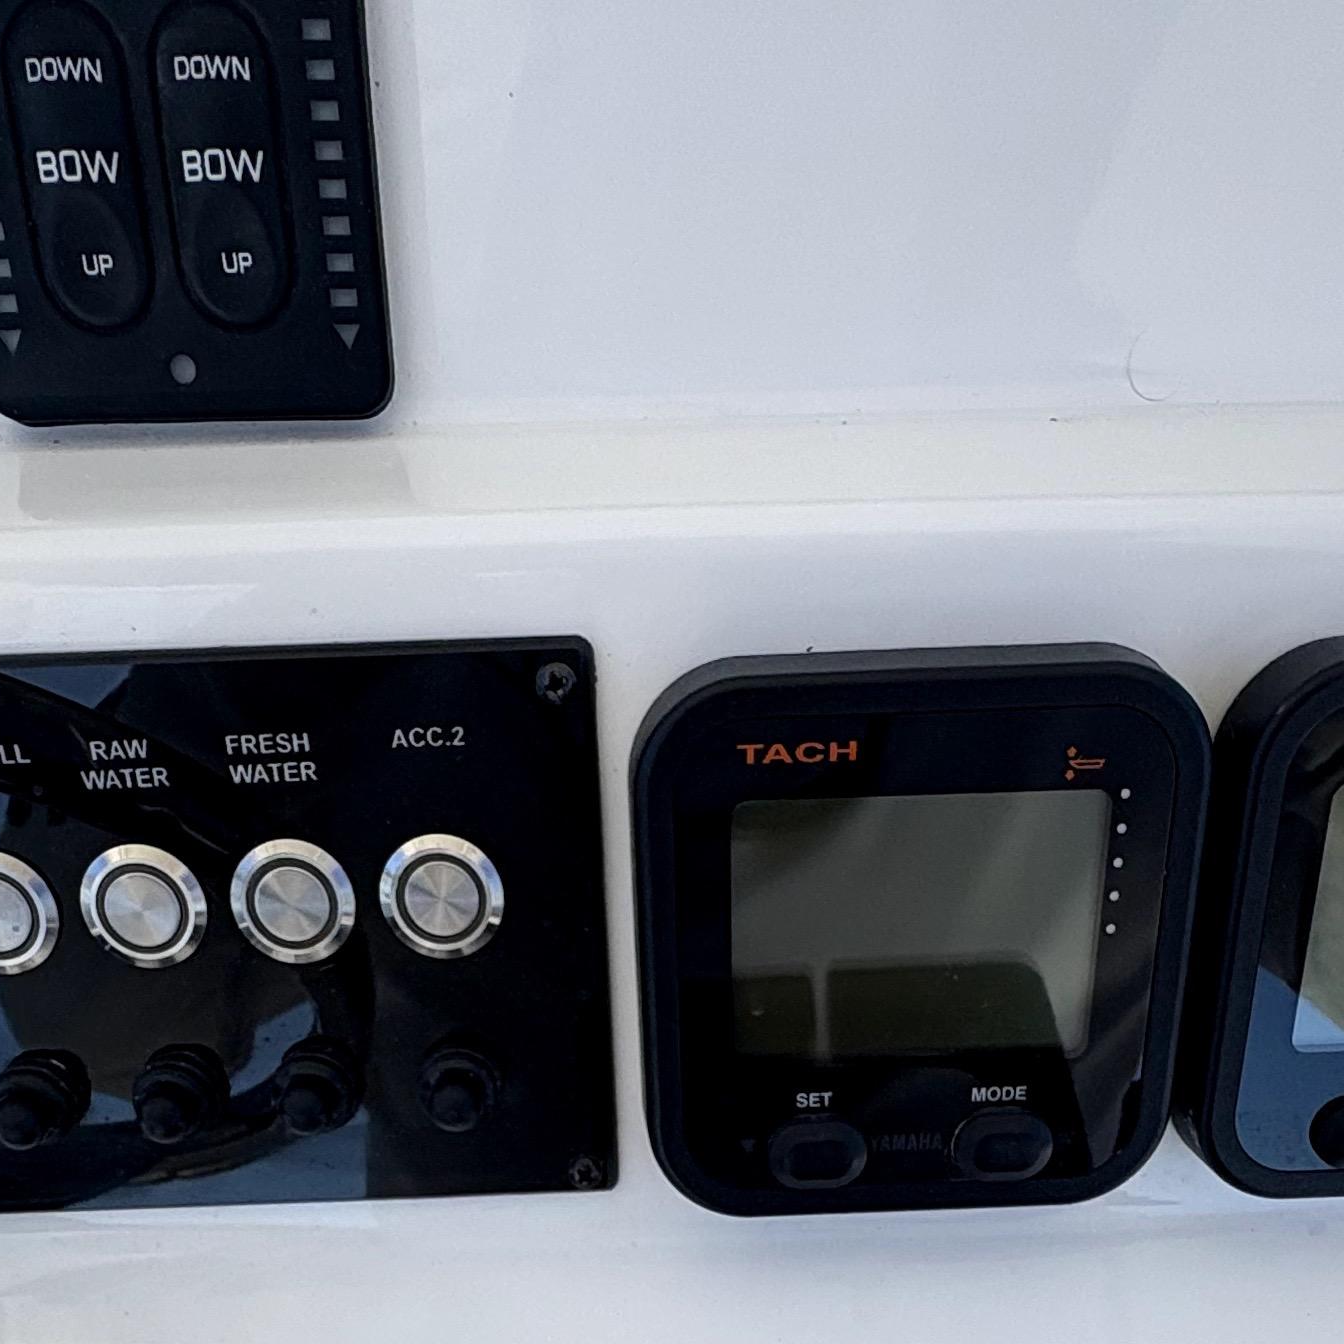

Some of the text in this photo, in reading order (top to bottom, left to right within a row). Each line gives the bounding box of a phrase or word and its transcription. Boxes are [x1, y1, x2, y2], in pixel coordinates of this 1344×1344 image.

[25, 57, 102, 82] DOWN
[174, 55, 250, 80] DOWN
[36, 150, 118, 183] BOW
[182, 149, 263, 182] BOW
[82, 255, 113, 275] UP
[222, 253, 252, 273] UP
[225, 733, 309, 754] FRESH
[392, 727, 465, 747] ACC.2
[90, 739, 146, 760] RAW
[737, 741, 857, 764] TACH
[81, 768, 169, 789] WATER
[229, 762, 317, 783] WATER
[797, 1092, 832, 1107] SET
[972, 1086, 1026, 1101] MODE
